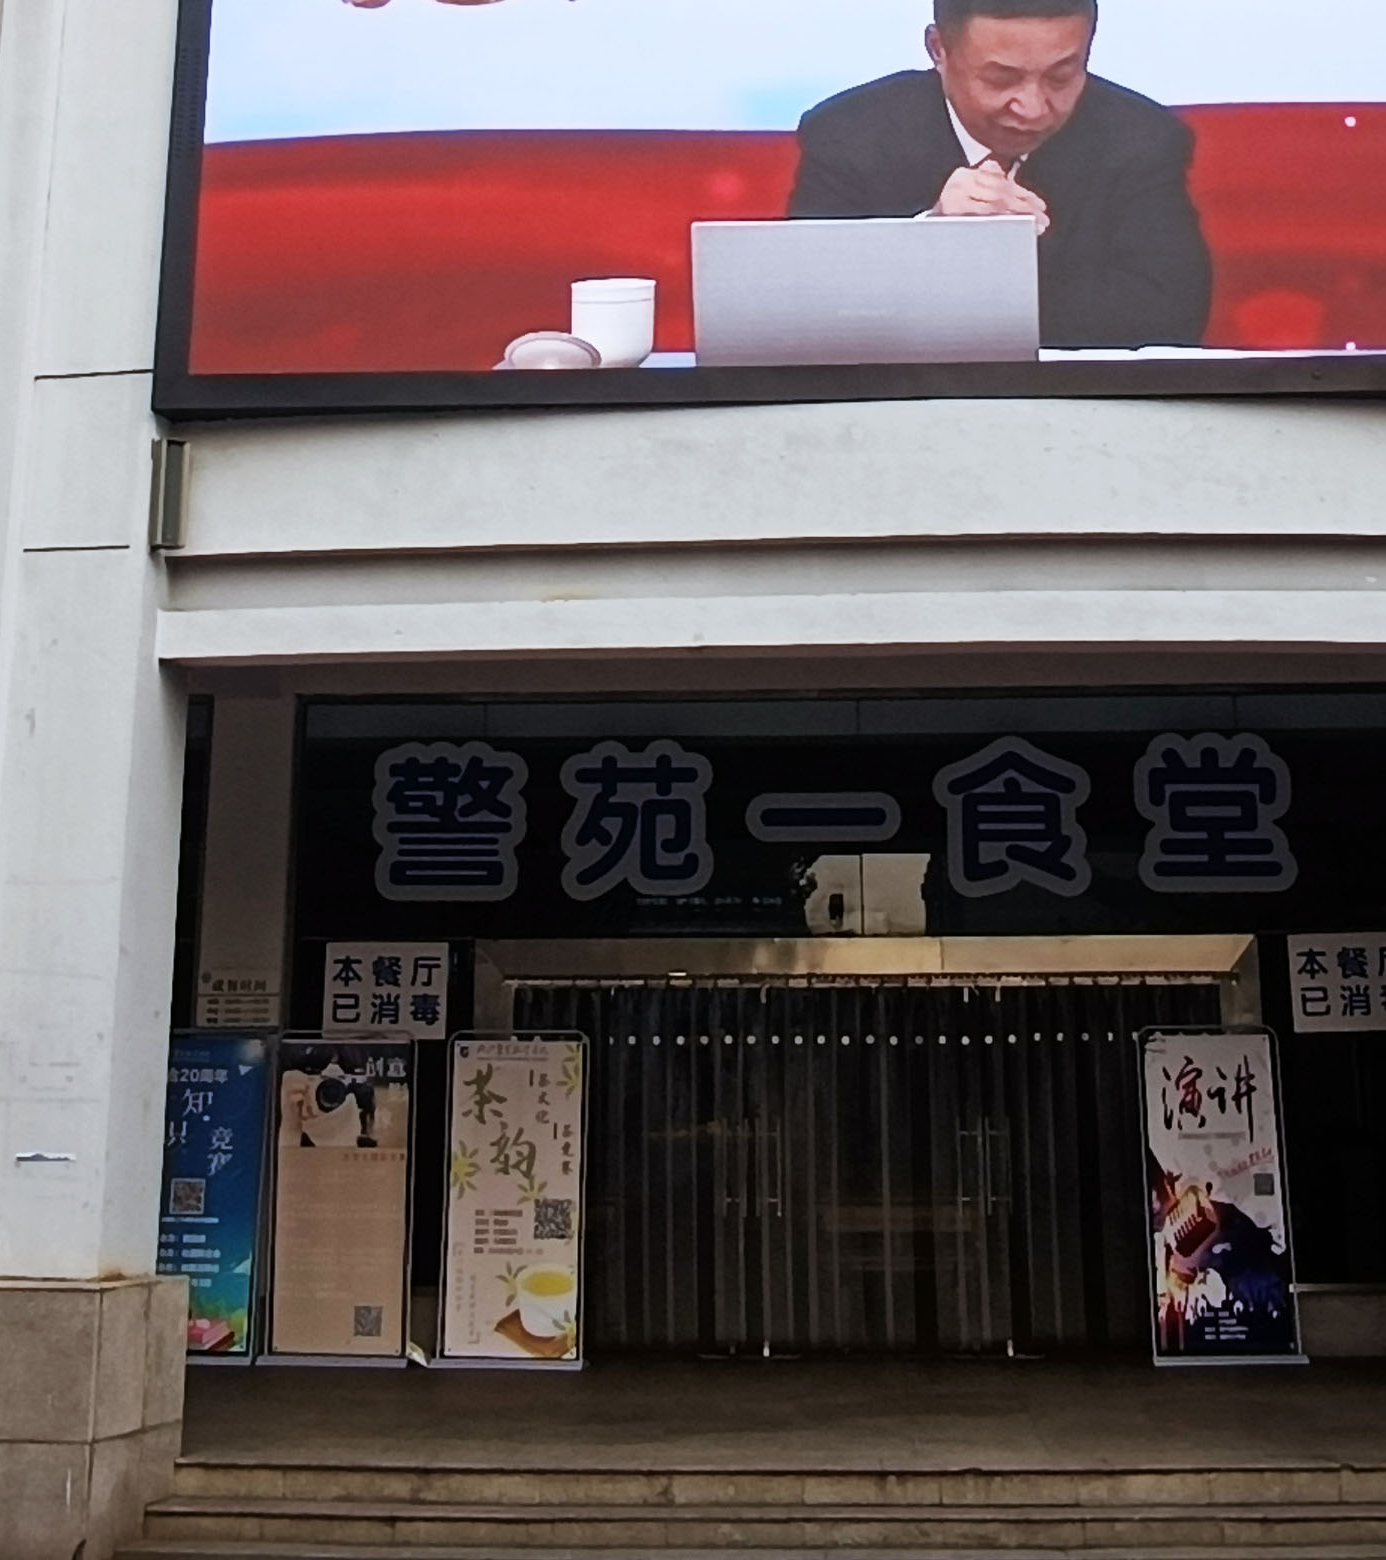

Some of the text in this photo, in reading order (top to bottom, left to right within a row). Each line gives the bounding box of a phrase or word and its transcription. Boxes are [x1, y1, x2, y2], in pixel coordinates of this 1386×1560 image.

[372, 732, 1298, 901] 警苑一食堂
[332, 955, 442, 987] 本餐厅
[332, 993, 441, 1026] 已消毒
[1161, 1054, 1257, 1144] 演讲
